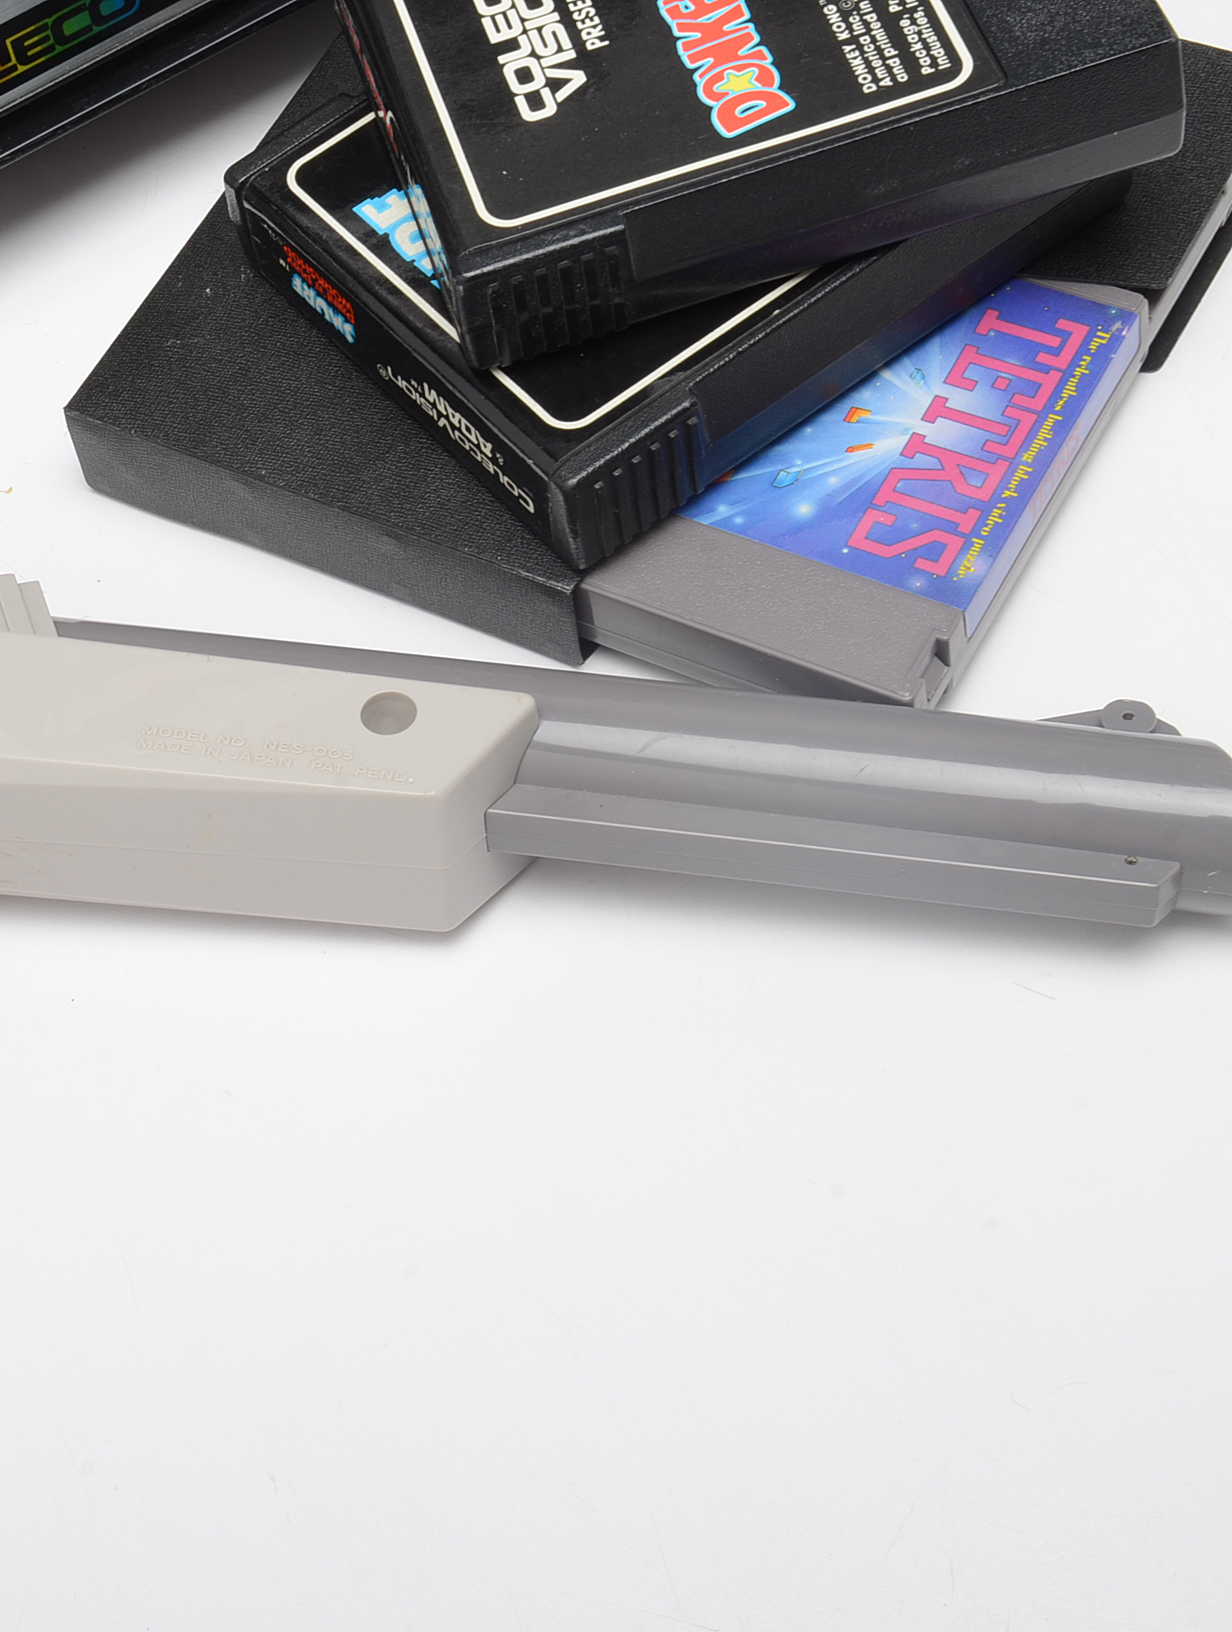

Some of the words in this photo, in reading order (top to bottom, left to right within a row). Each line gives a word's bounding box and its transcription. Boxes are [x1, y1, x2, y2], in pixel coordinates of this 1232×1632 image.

[848, 11, 867, 35] Inc.
[862, 12, 899, 58] printed
[899, 14, 936, 75] Package,
[913, 6, 952, 70] Industries,
[657, 0, 796, 138] DONKE
[841, 44, 878, 94] DONKEY
[858, 34, 894, 87] America
[885, 57, 909, 83] and
[1088, 331, 1113, 353] The
[1054, 355, 1092, 411] relentless
[846, 308, 1091, 577] TETRIS
[1022, 413, 1063, 463] building
[1001, 465, 1033, 498] block
[980, 503, 1007, 536] video
[952, 537, 986, 581] puzzle.
[137, 738, 192, 755] MADE
[200, 746, 221, 759] IN
[229, 749, 294, 768] JAPAN
[141, 725, 209, 743] MODEL
[217, 735, 250, 749] NO.
[263, 740, 354, 761] NES-005
